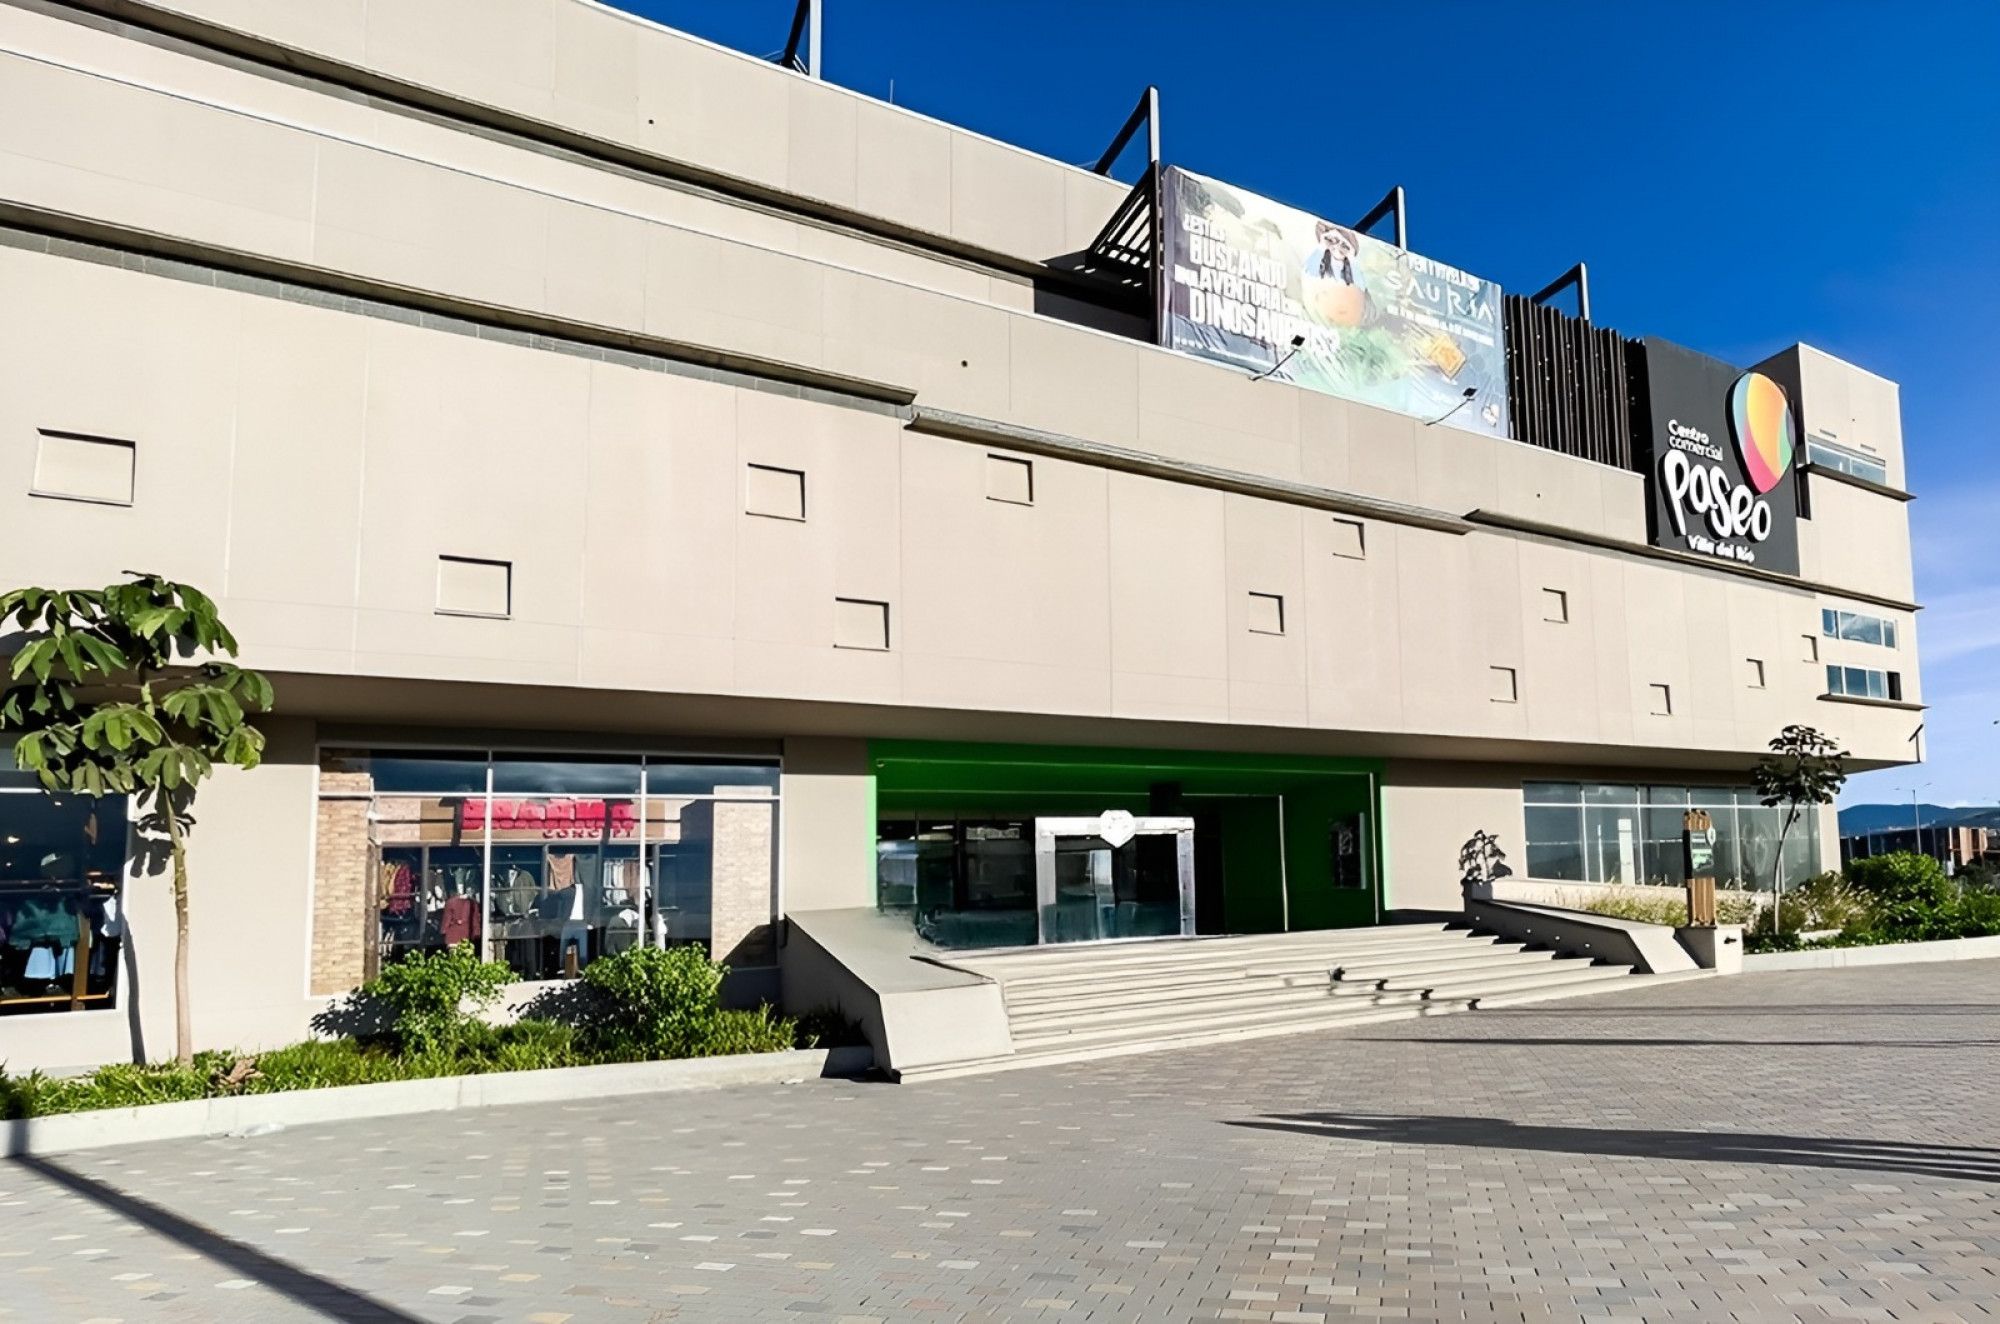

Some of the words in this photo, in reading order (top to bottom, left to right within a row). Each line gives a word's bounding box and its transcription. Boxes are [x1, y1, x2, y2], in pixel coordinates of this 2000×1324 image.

[1669, 419, 1709, 444] Centro
[1665, 449, 1771, 541] Paseo
[542, 828, 633, 839] CONCPT
